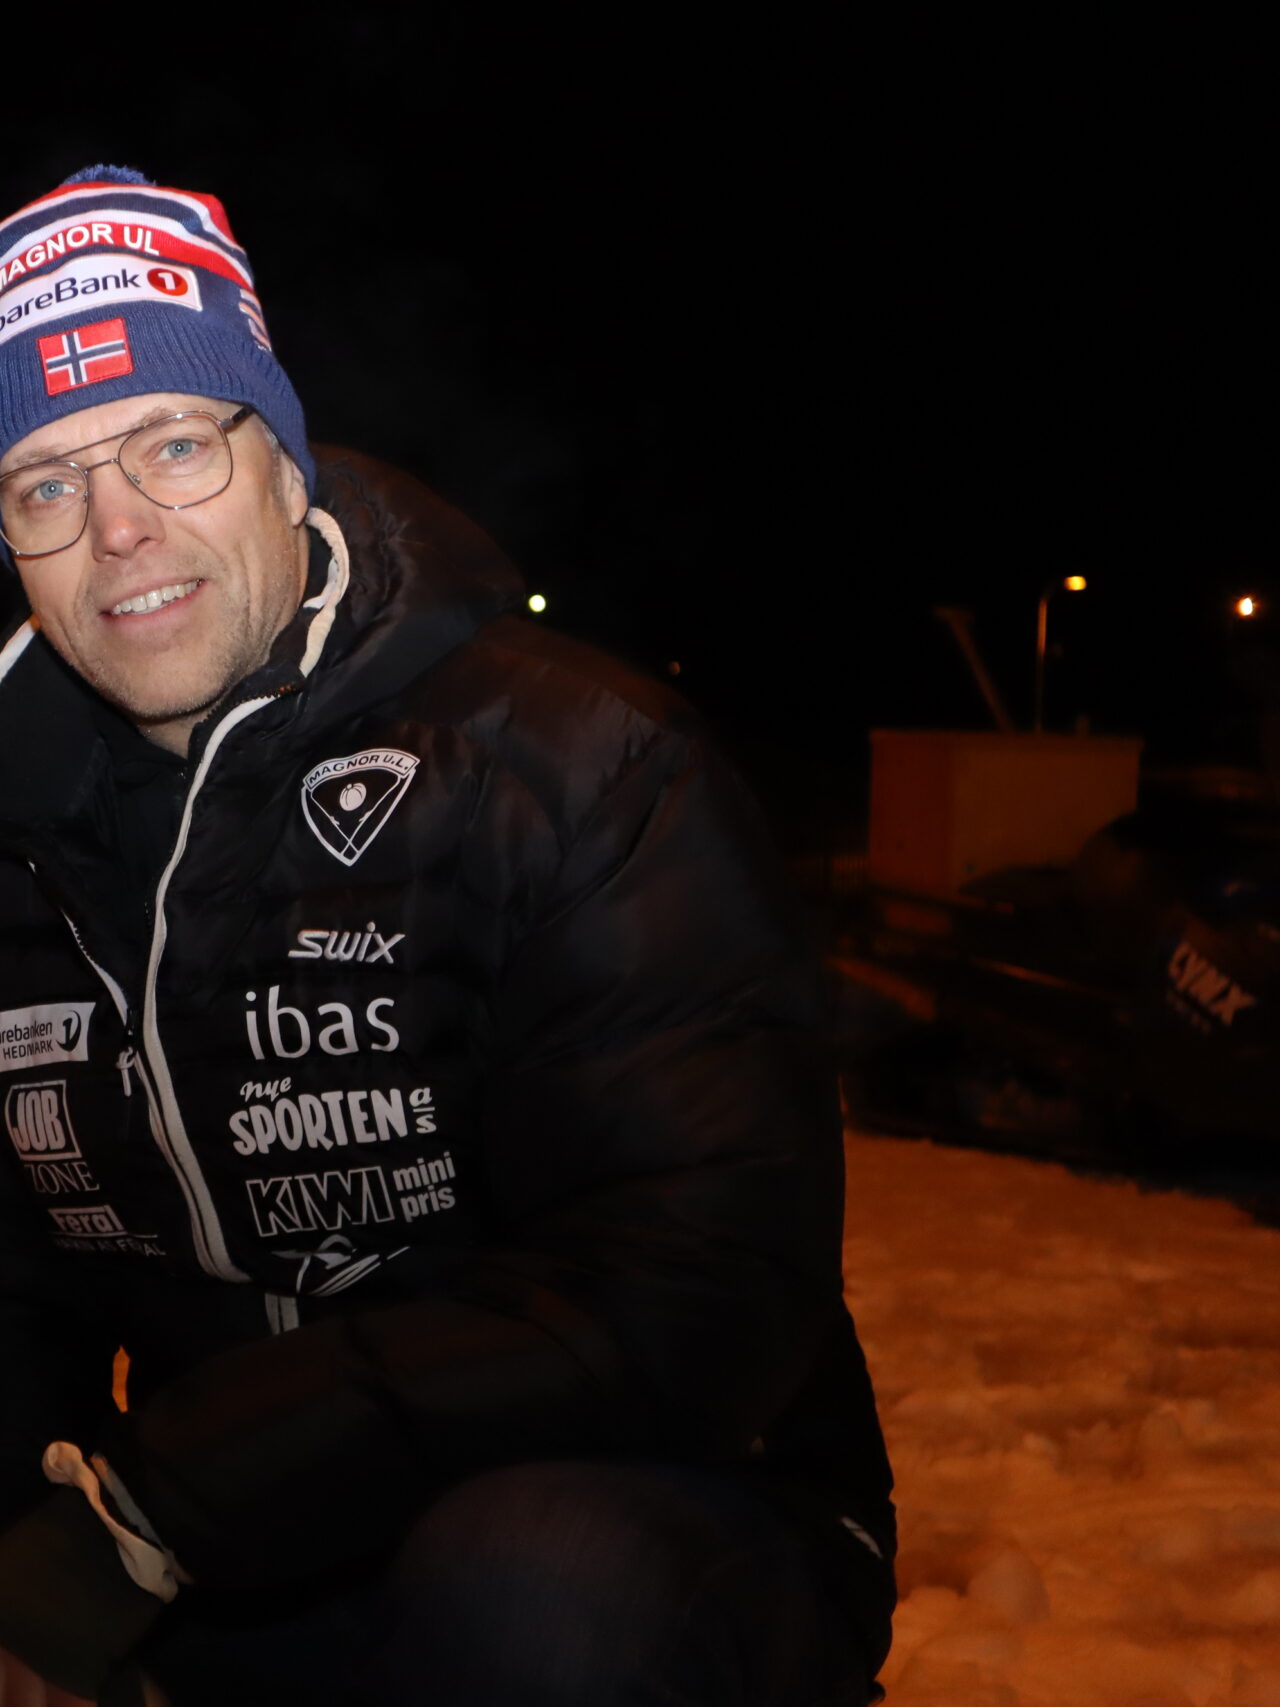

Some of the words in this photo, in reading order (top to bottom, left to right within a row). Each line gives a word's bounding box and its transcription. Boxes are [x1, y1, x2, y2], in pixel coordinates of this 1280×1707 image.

[123, 226, 160, 256] UL
[308, 754, 380, 785] MAGNOR
[382, 754, 409, 771] U.L.
[245, 984, 400, 1060] ibas
[3, 1039, 54, 1061] HEDMARK
[239, 1076, 292, 1102] nye
[13, 1089, 67, 1152] JOB
[229, 1088, 409, 1156] SPORTEN
[23, 1161, 101, 1195] ZONE
[392, 1151, 457, 1192] mini
[245, 1165, 396, 1238] KIWI
[400, 1184, 457, 1223] pris
